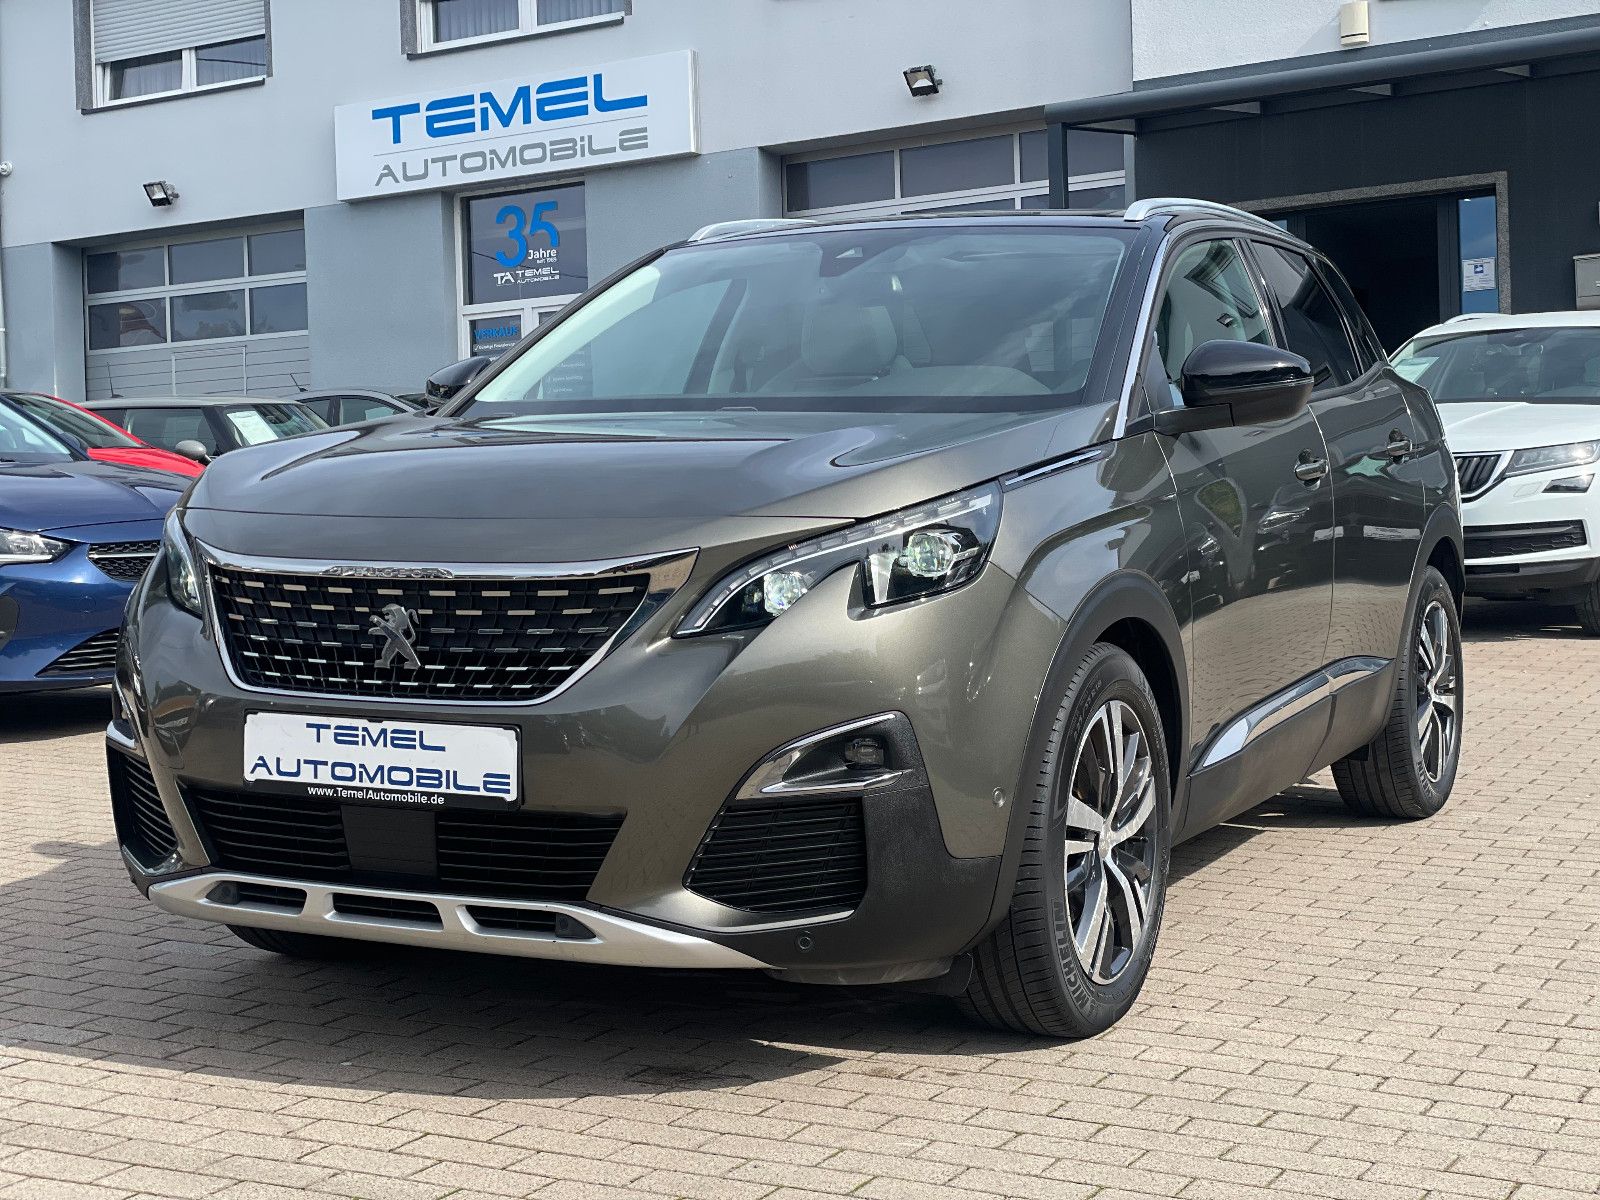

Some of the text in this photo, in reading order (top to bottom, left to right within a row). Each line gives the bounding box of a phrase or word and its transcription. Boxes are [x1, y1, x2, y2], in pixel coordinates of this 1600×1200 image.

[371, 73, 648, 145] TEMEL
[495, 200, 560, 269] 35
[527, 248, 557, 260] Jahre
[493, 270, 515, 286] TA
[516, 267, 560, 277] TEMEL
[306, 722, 447, 752] TEMEL
[249, 755, 511, 795] AUTOMOBILE
[307, 785, 445, 805] www.TemelAutomobile.de
